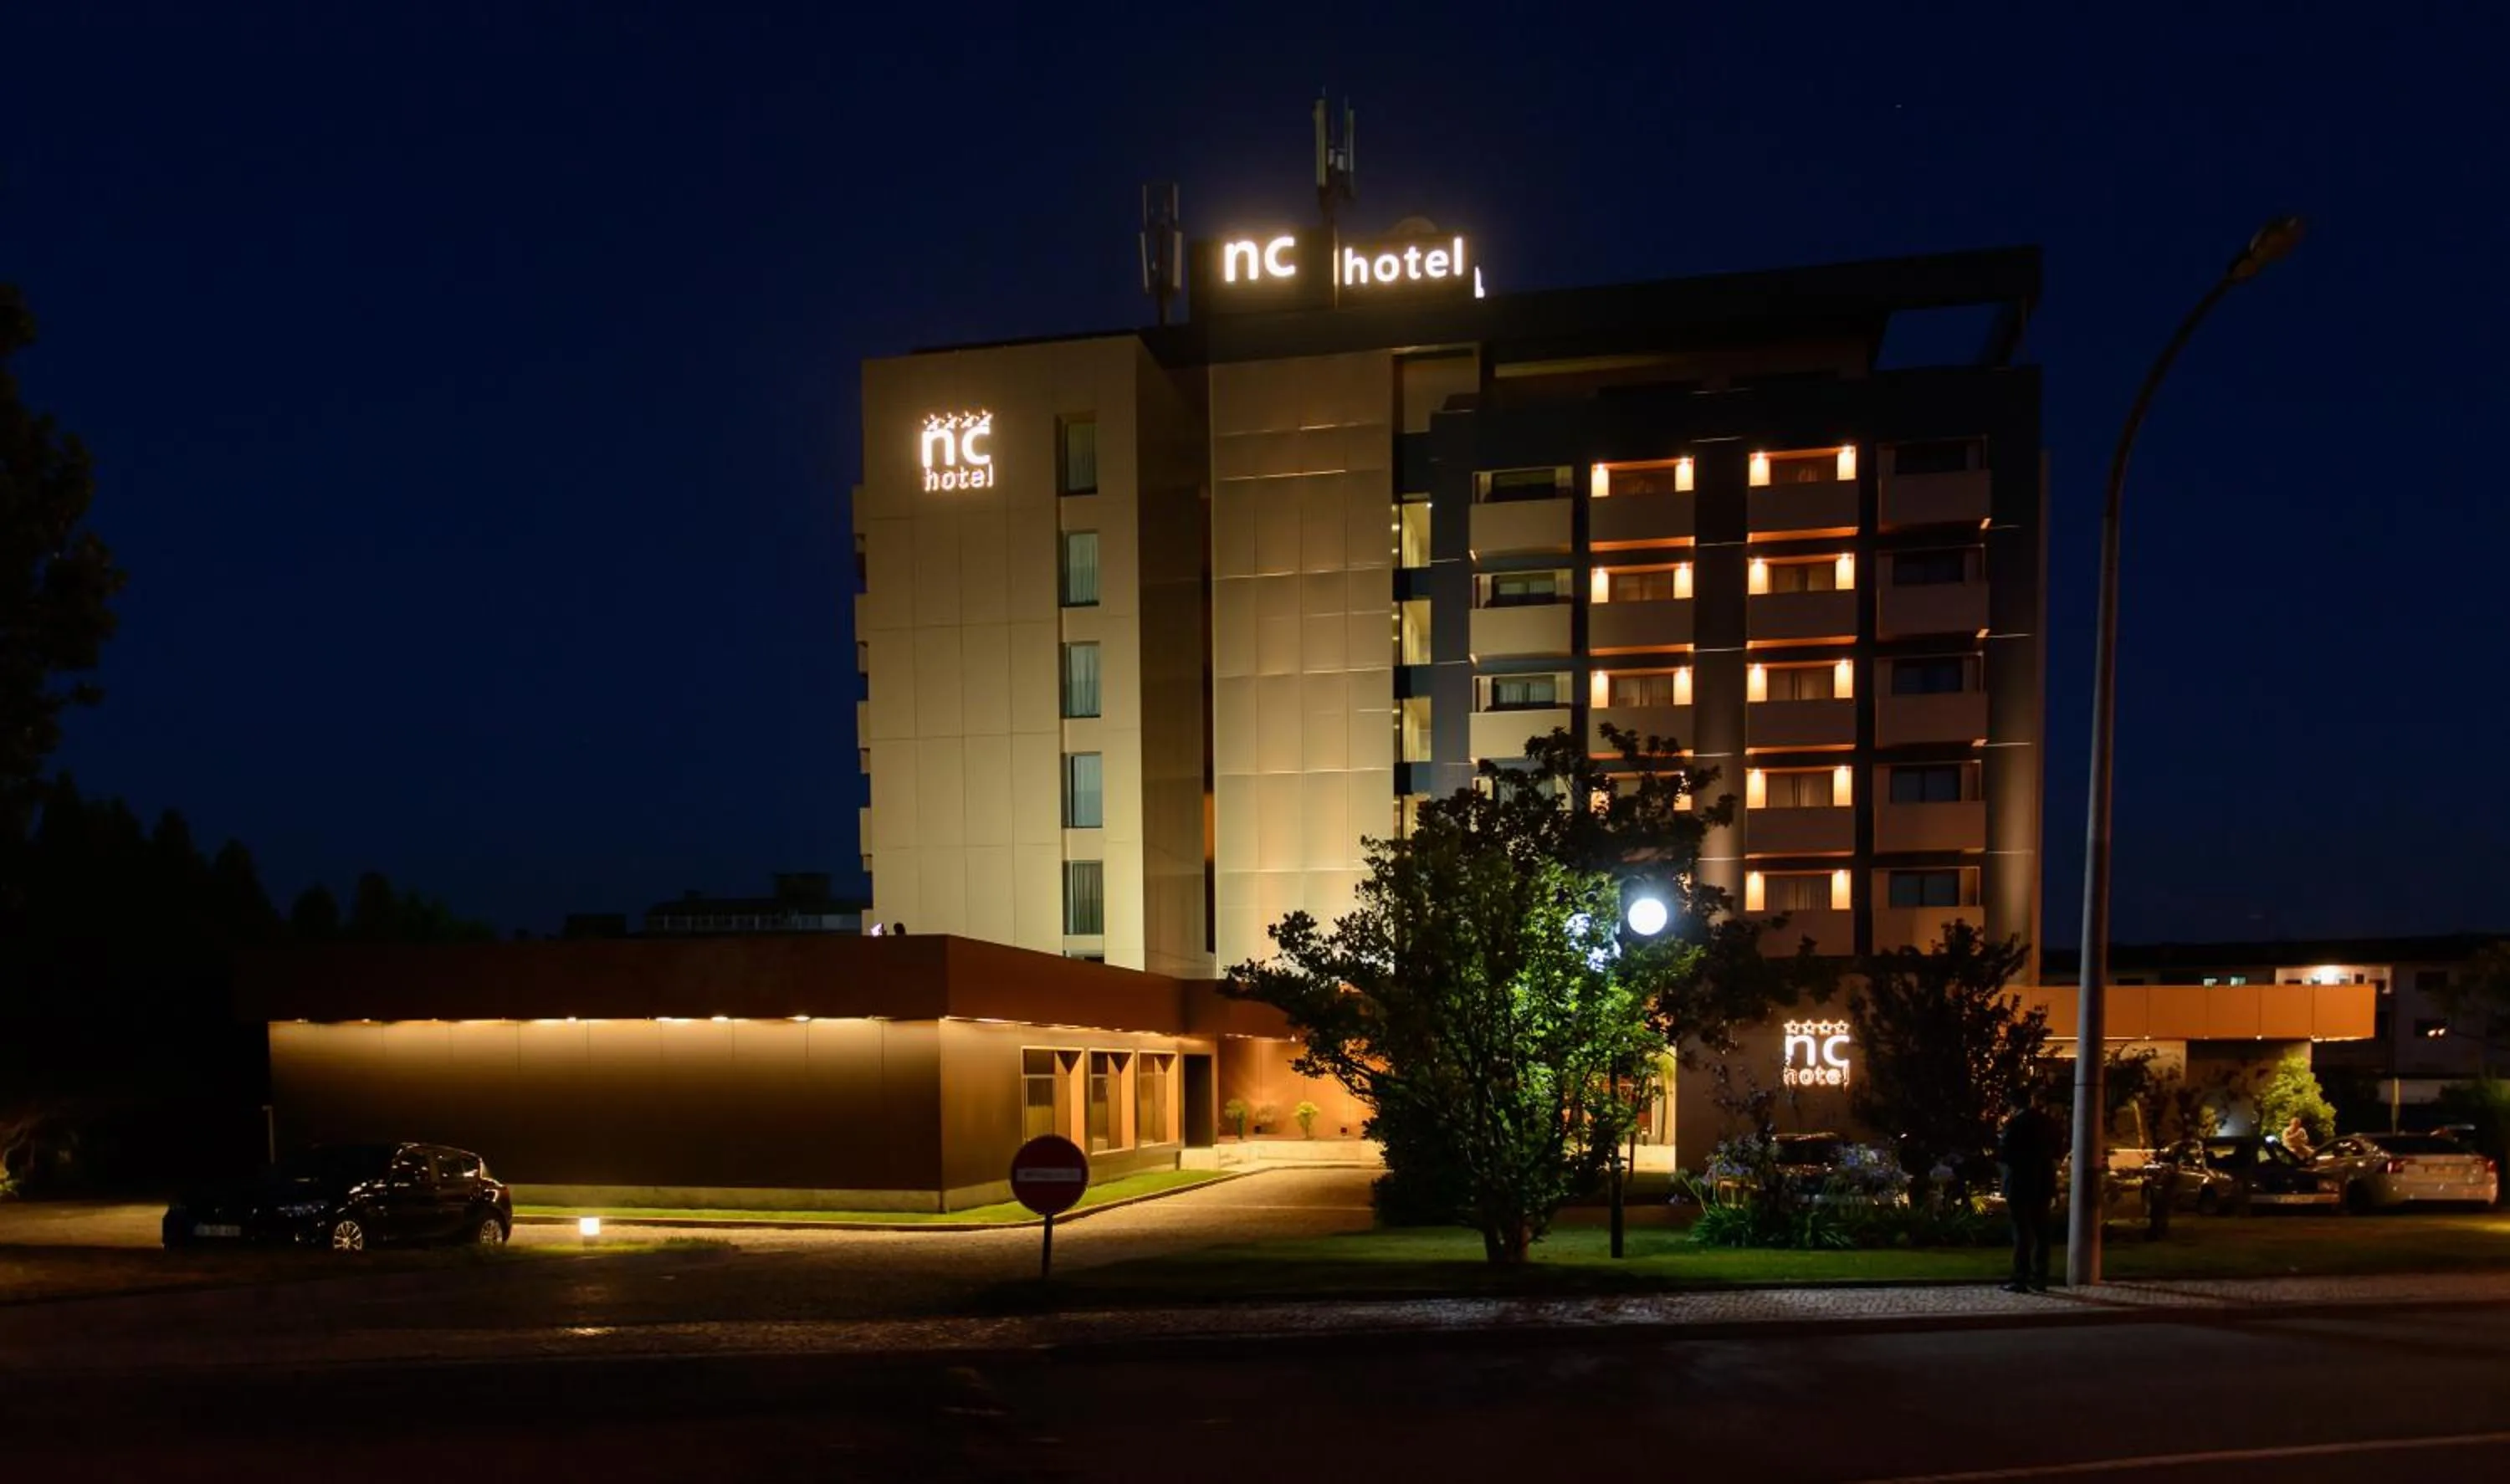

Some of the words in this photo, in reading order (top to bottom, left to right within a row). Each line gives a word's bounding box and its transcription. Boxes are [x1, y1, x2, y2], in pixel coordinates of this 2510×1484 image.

[1224, 236, 1296, 282] nc
[1344, 237, 1463, 285] hotel
[921, 426, 991, 468] nc
[924, 464, 994, 492] hotel
[1785, 1035, 1850, 1067] nc
[1783, 1065, 1850, 1087] hotel
